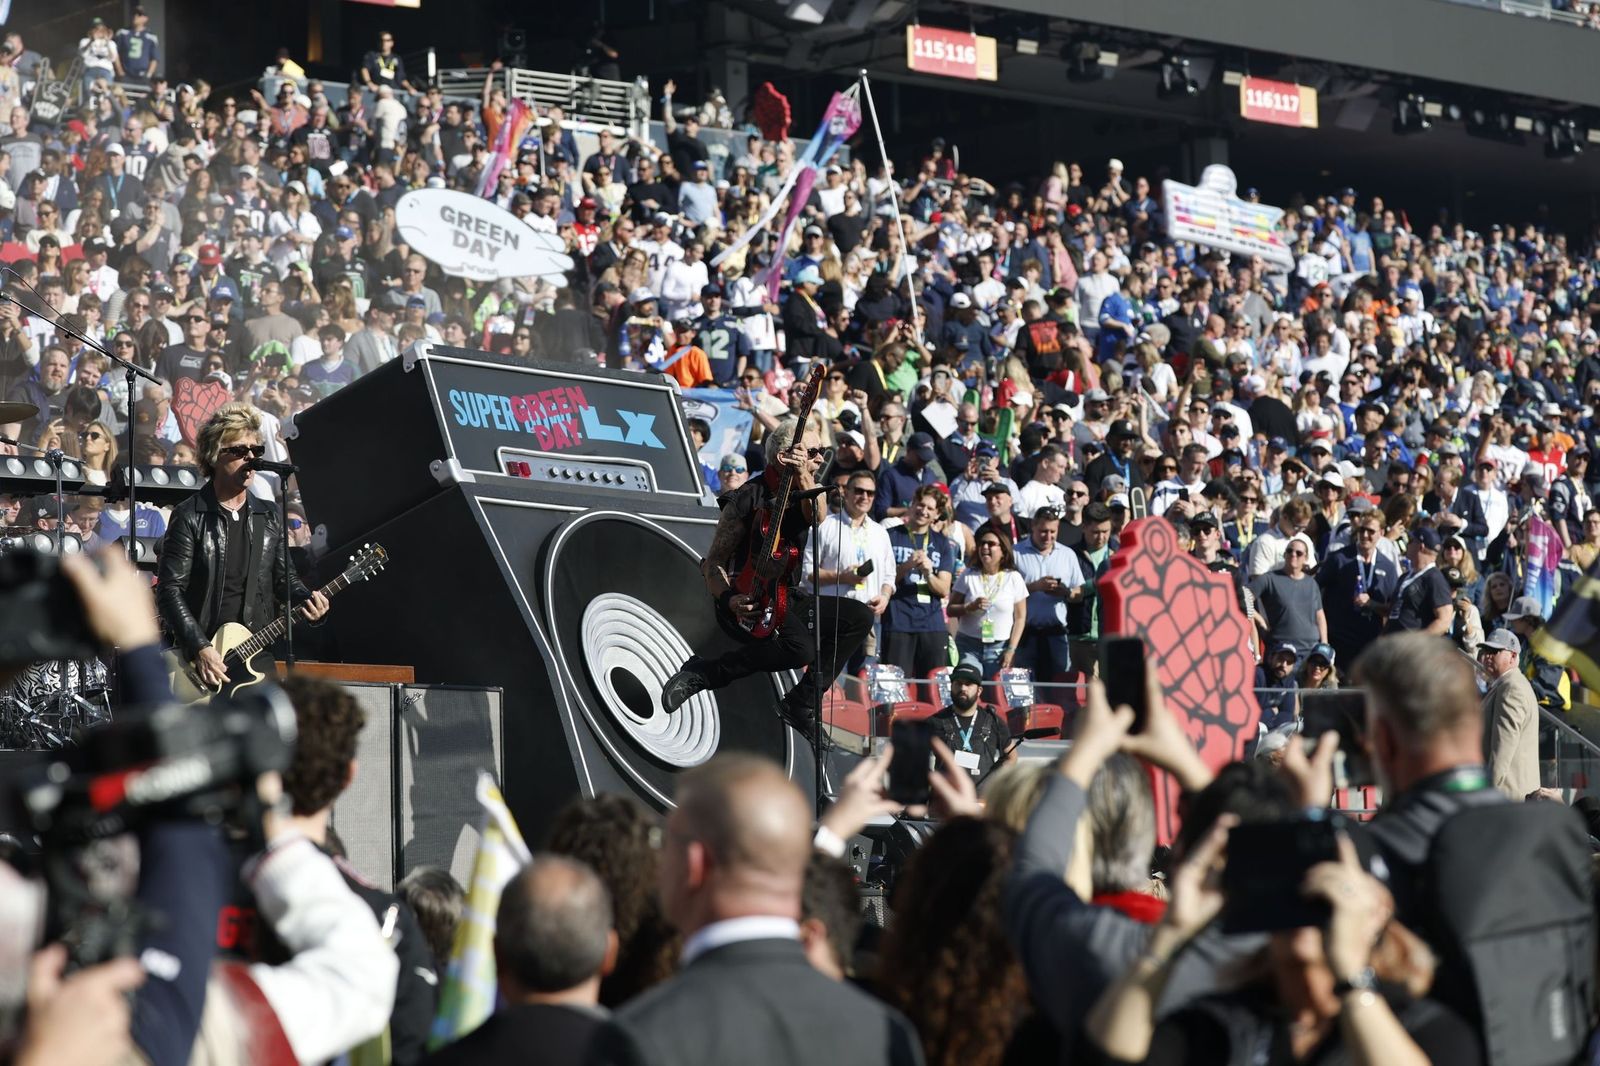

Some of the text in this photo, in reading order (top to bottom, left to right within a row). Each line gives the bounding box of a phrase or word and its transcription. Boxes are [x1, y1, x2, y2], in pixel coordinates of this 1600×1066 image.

[128, 37, 143, 60] 3
[914, 38, 976, 65] 115 116
[1246, 88, 1300, 112] 116 117
[440, 204, 520, 251] GREEN
[450, 228, 502, 262] DAY
[698, 328, 730, 360] 12
[449, 389, 520, 432] SUPER
[579, 405, 666, 449] LX
[510, 386, 590, 422] GREEN
[533, 419, 582, 451] DAY
